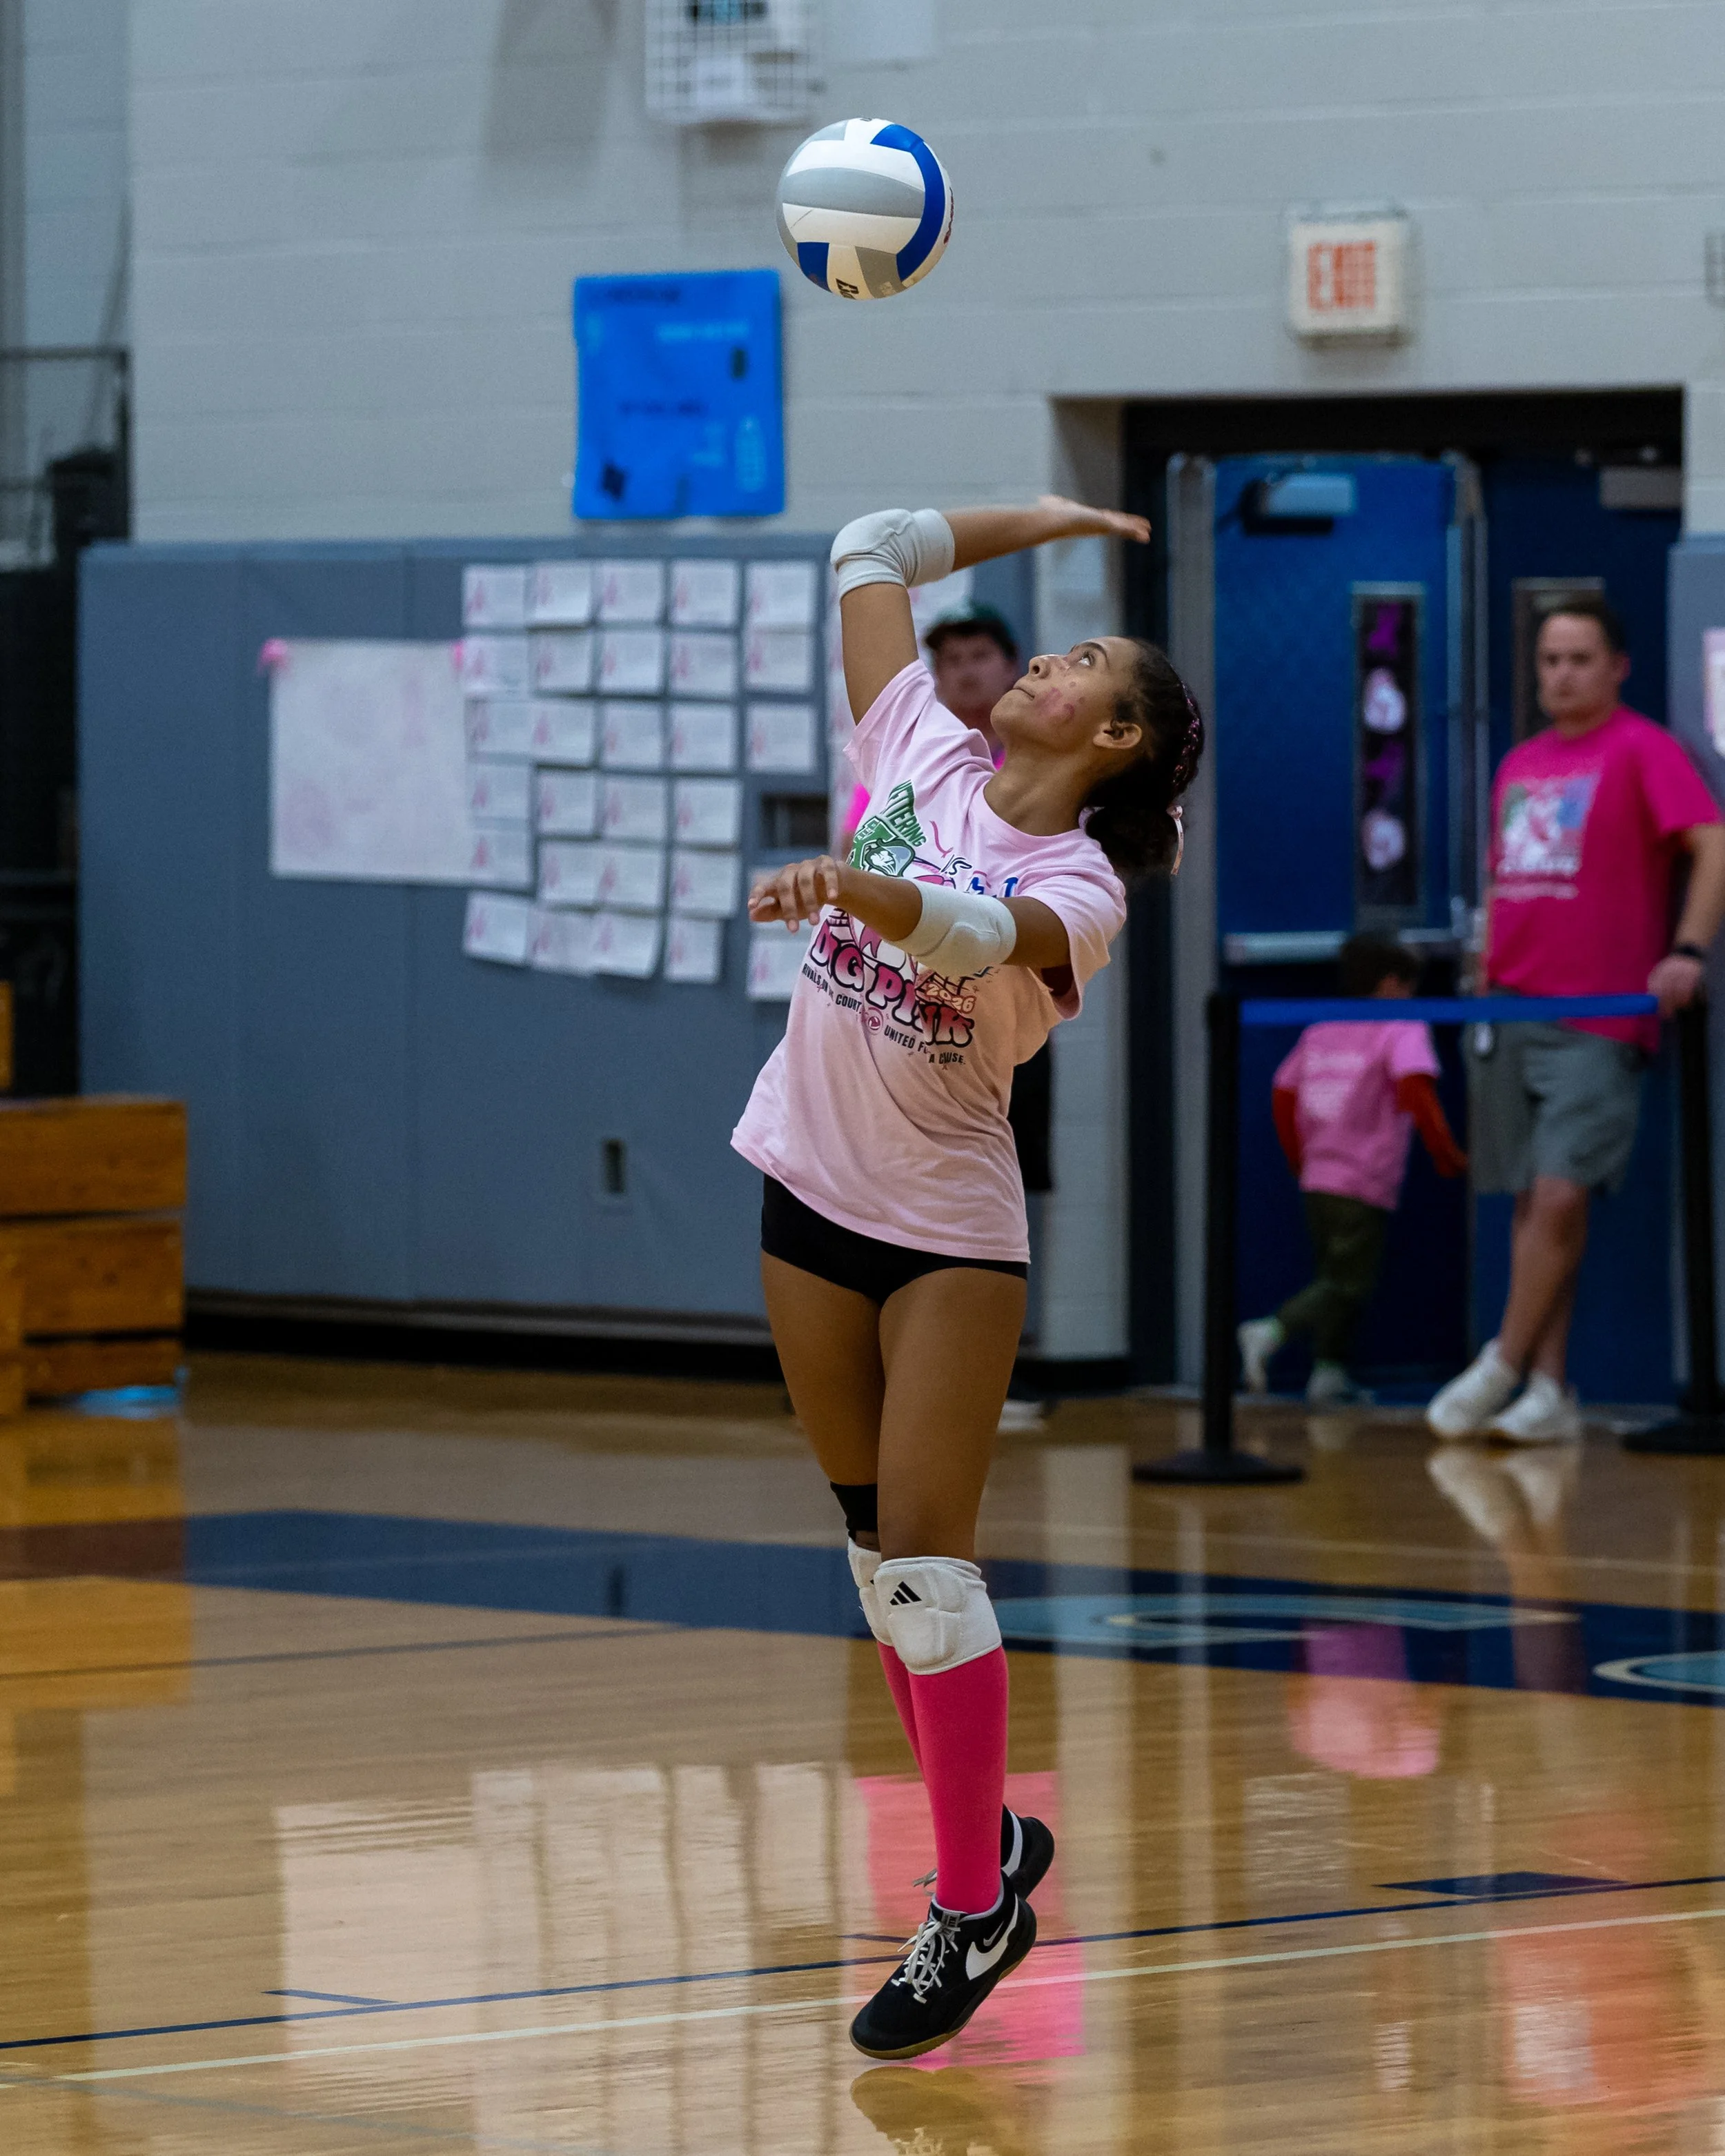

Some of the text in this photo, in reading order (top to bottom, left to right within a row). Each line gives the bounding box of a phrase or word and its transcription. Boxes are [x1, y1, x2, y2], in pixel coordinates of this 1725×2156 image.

[802, 963, 822, 986] RIVALS
[925, 984, 977, 1014] 2026
[884, 1025, 916, 1049] UNITED
[929, 1054, 935, 1063] A
